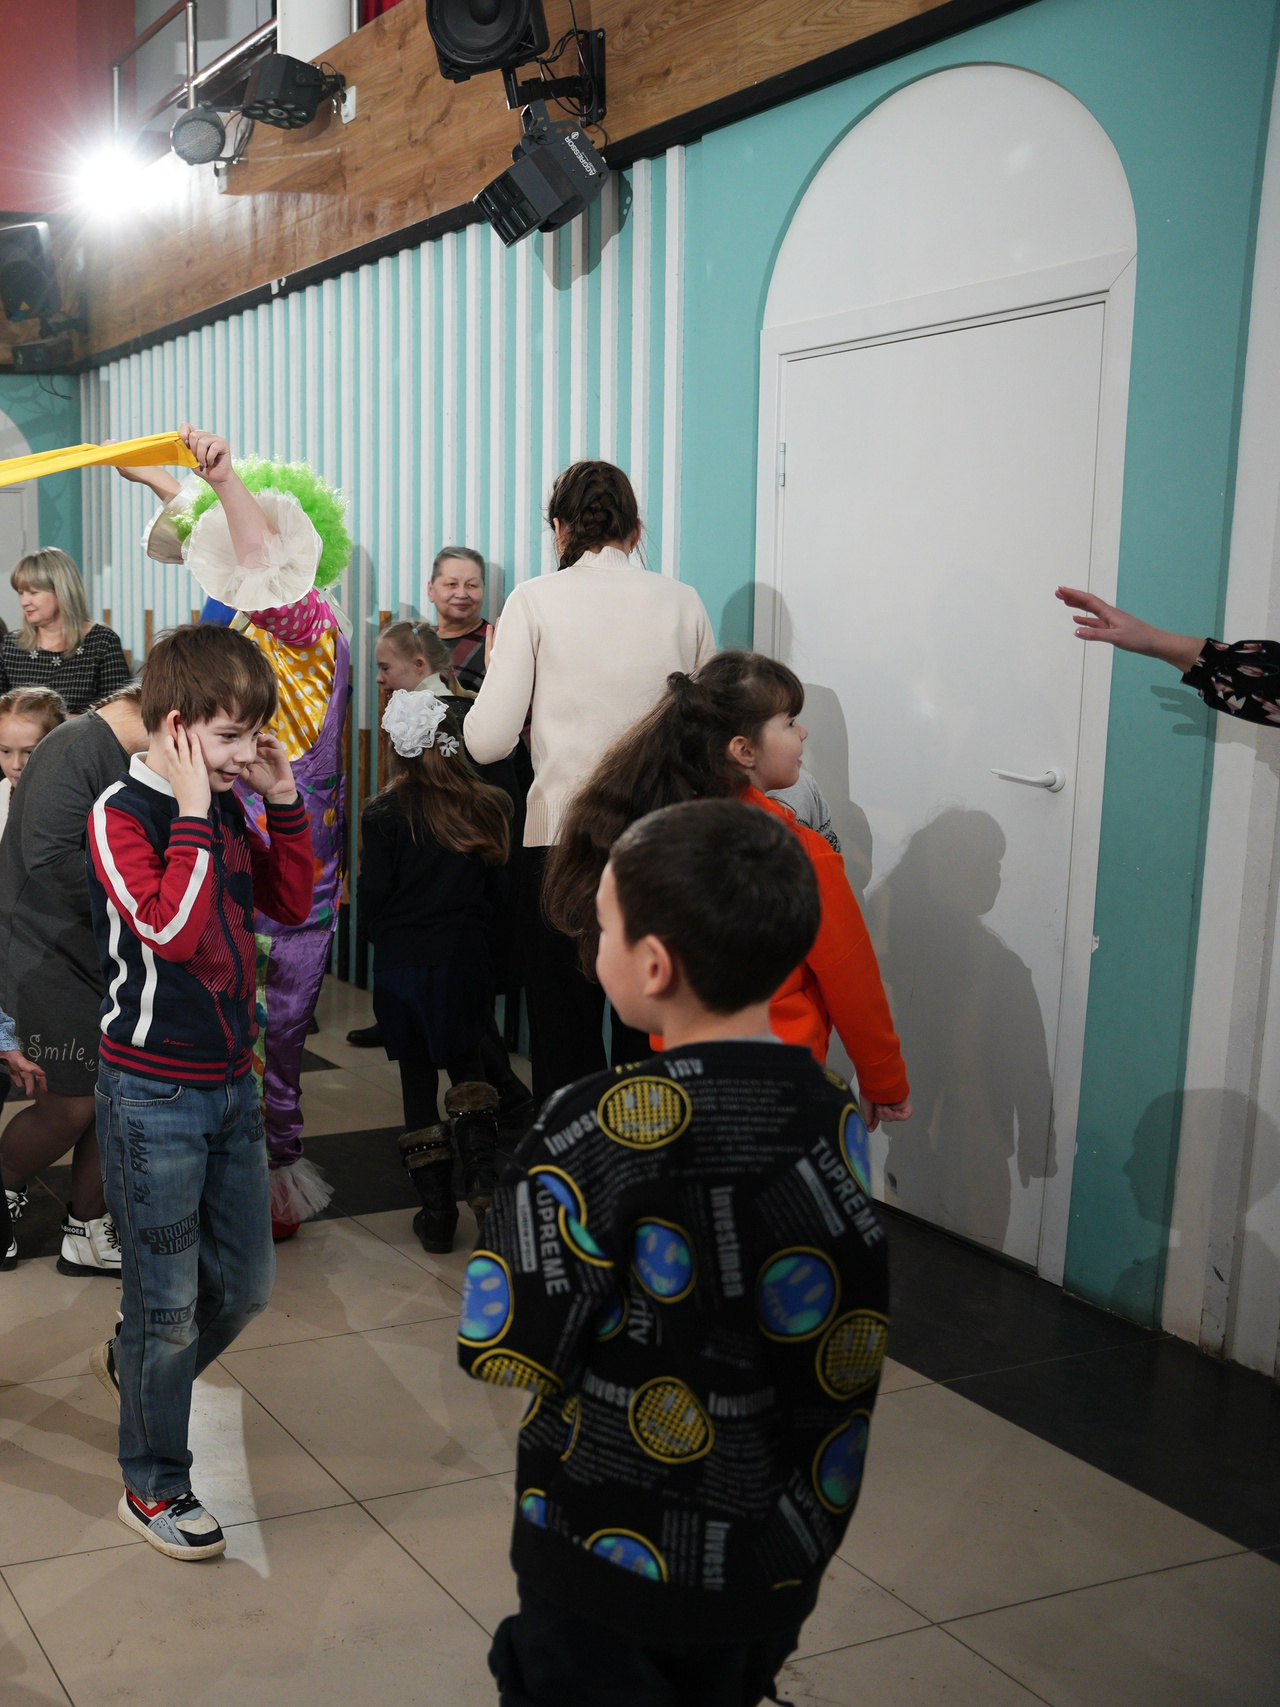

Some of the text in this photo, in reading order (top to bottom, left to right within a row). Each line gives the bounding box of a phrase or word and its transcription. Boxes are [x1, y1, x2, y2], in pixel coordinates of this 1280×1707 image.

[27, 1034, 85, 1062] Smile
[126, 1116, 152, 1178] BRAVE
[810, 1136, 884, 1248] TUPREME
[146, 1214, 196, 1243] STRONG
[535, 1180, 571, 1296] UPREME
[154, 1309, 188, 1323] HAVE
